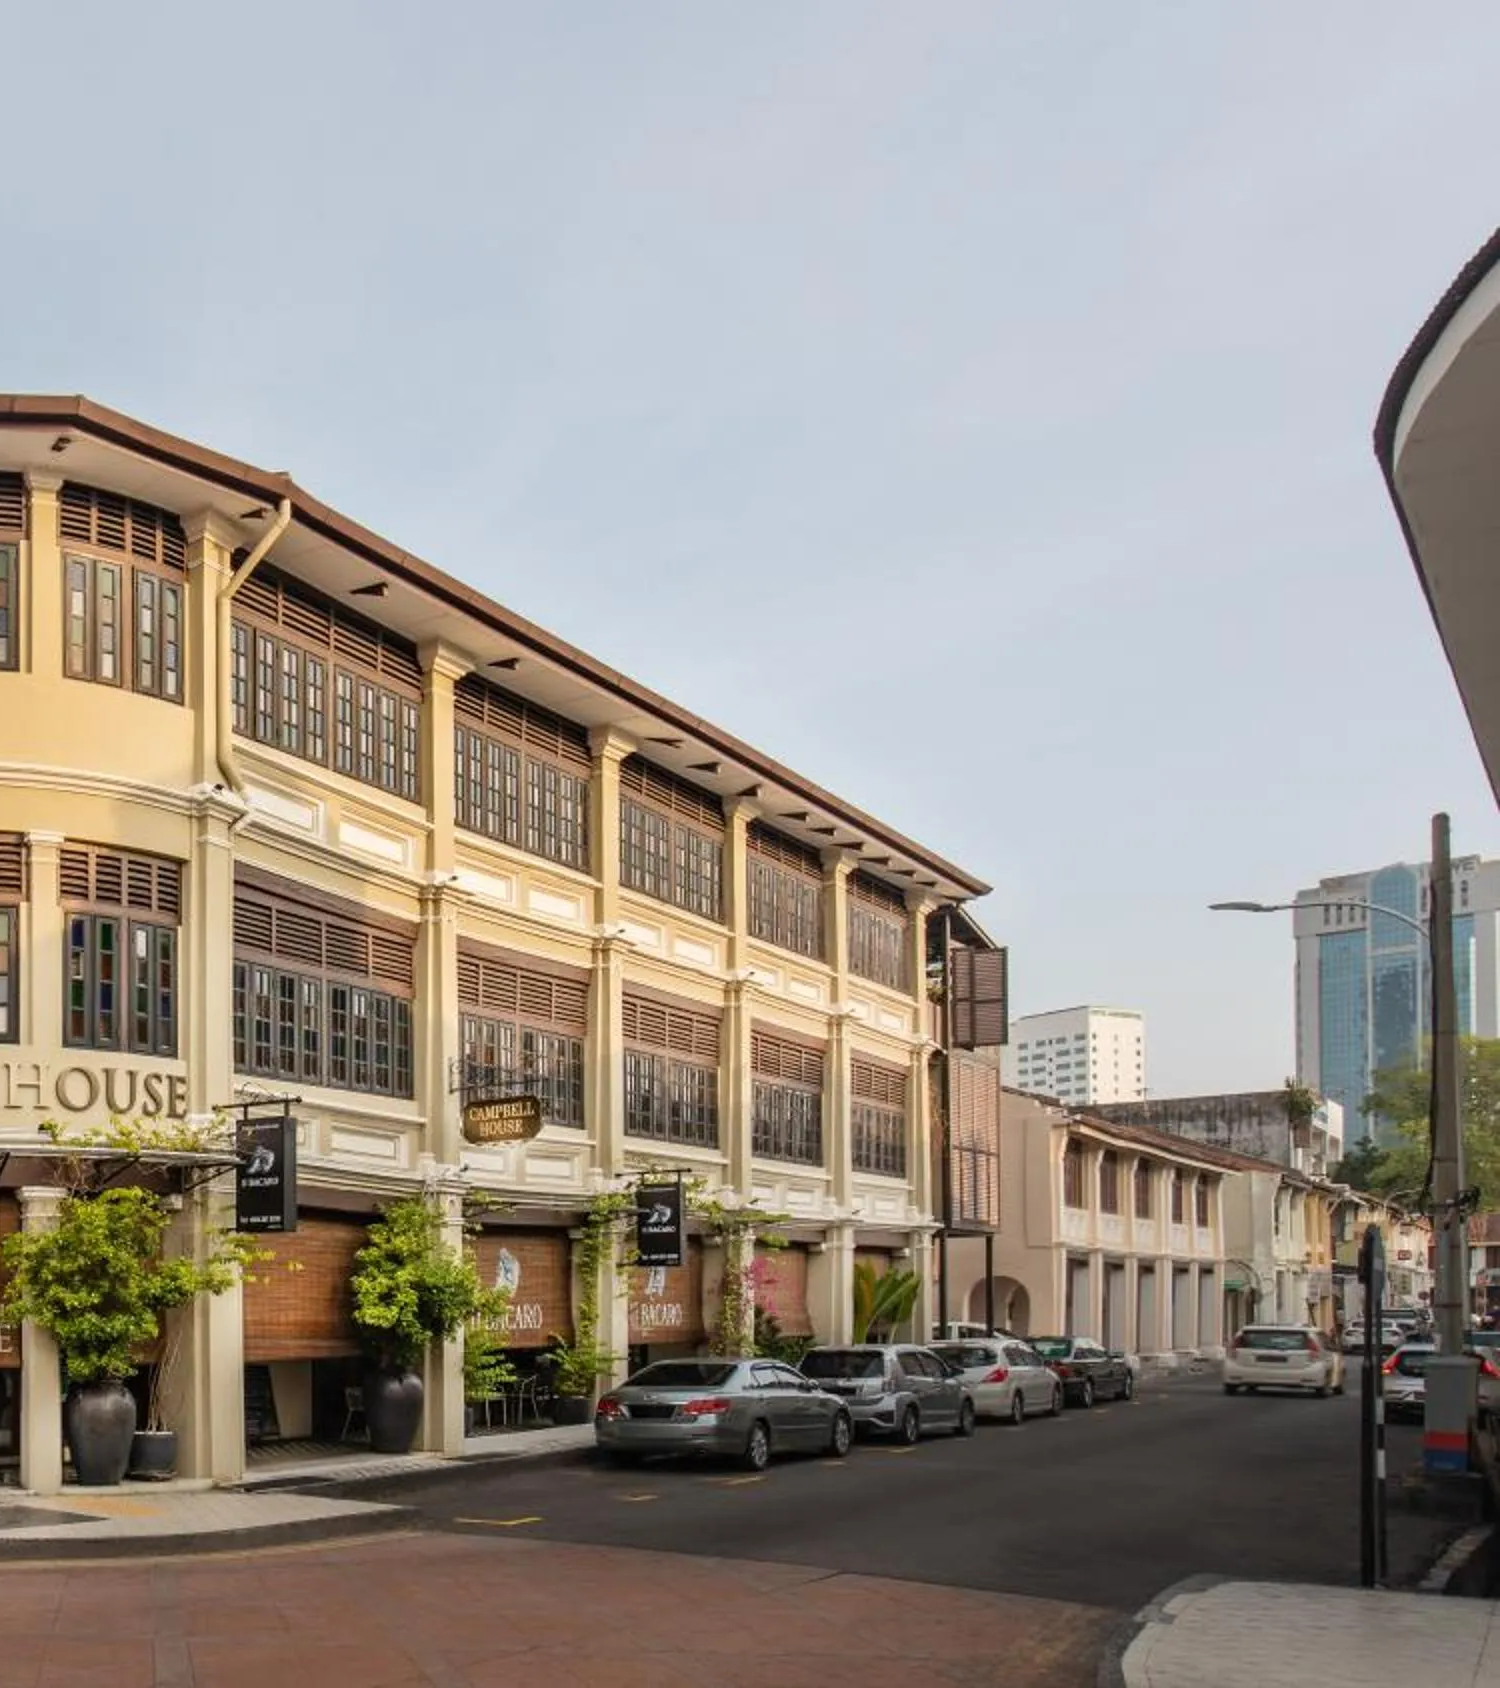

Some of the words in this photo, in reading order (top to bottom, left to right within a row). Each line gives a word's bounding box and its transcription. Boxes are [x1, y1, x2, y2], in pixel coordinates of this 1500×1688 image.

[3, 1063, 189, 1120] HOUSE
[469, 1101, 535, 1121] CAMPBELL
[480, 1118, 523, 1137] HOUSE
